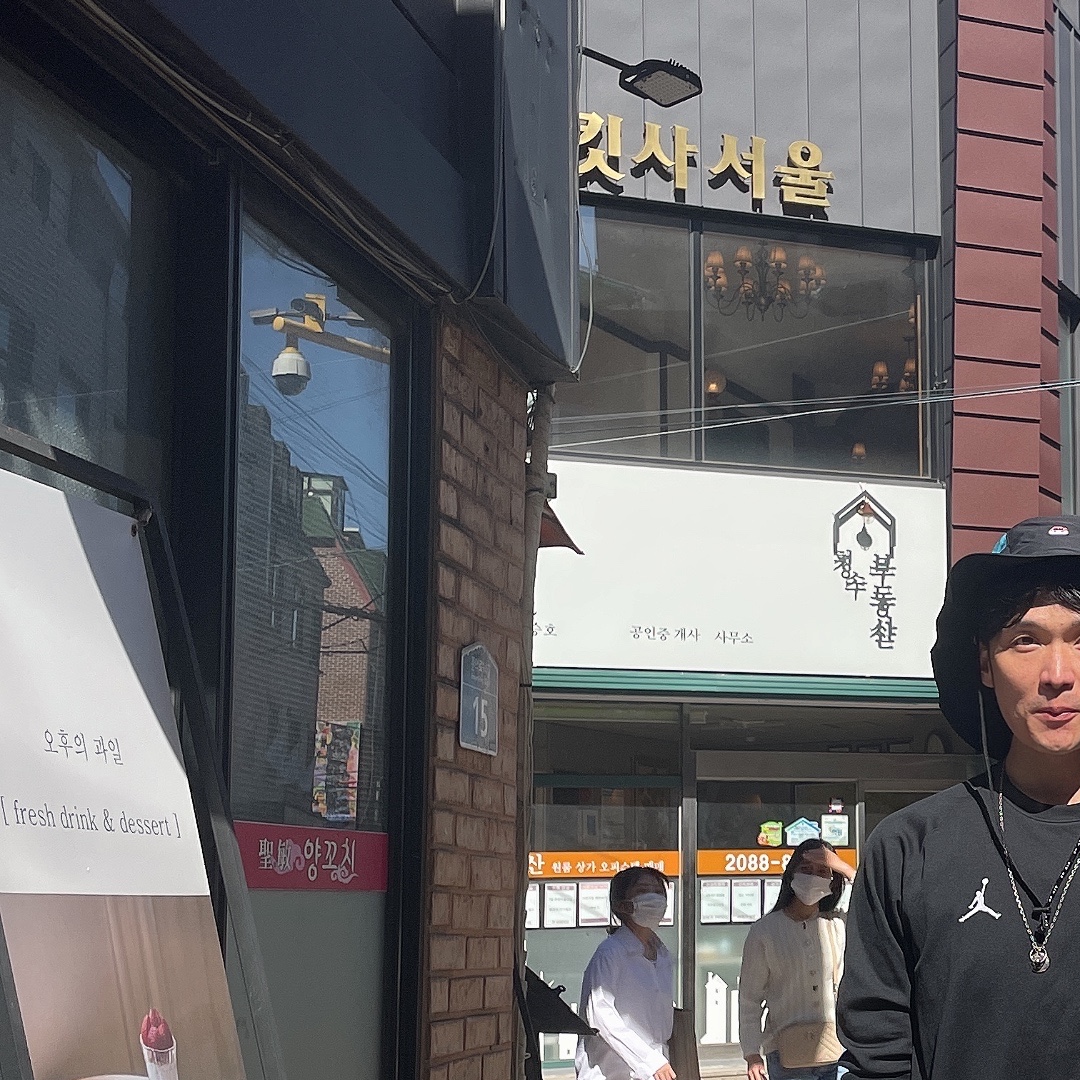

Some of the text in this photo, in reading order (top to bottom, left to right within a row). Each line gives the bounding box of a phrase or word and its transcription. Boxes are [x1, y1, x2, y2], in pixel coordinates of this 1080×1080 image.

[868, 553, 897, 650] 부동산
[714, 628, 754, 645] 사무소
[472, 696, 488, 738] 15
[44, 729, 124, 767] 오후의 과일
[14, 802, 56, 830] fresh
[60, 804, 99, 832] drink
[103, 809, 116, 833] &
[119, 811, 172, 838] dessert
[303, 837, 359, 883] 양꼬치
[575, 860, 597, 874] 상가
